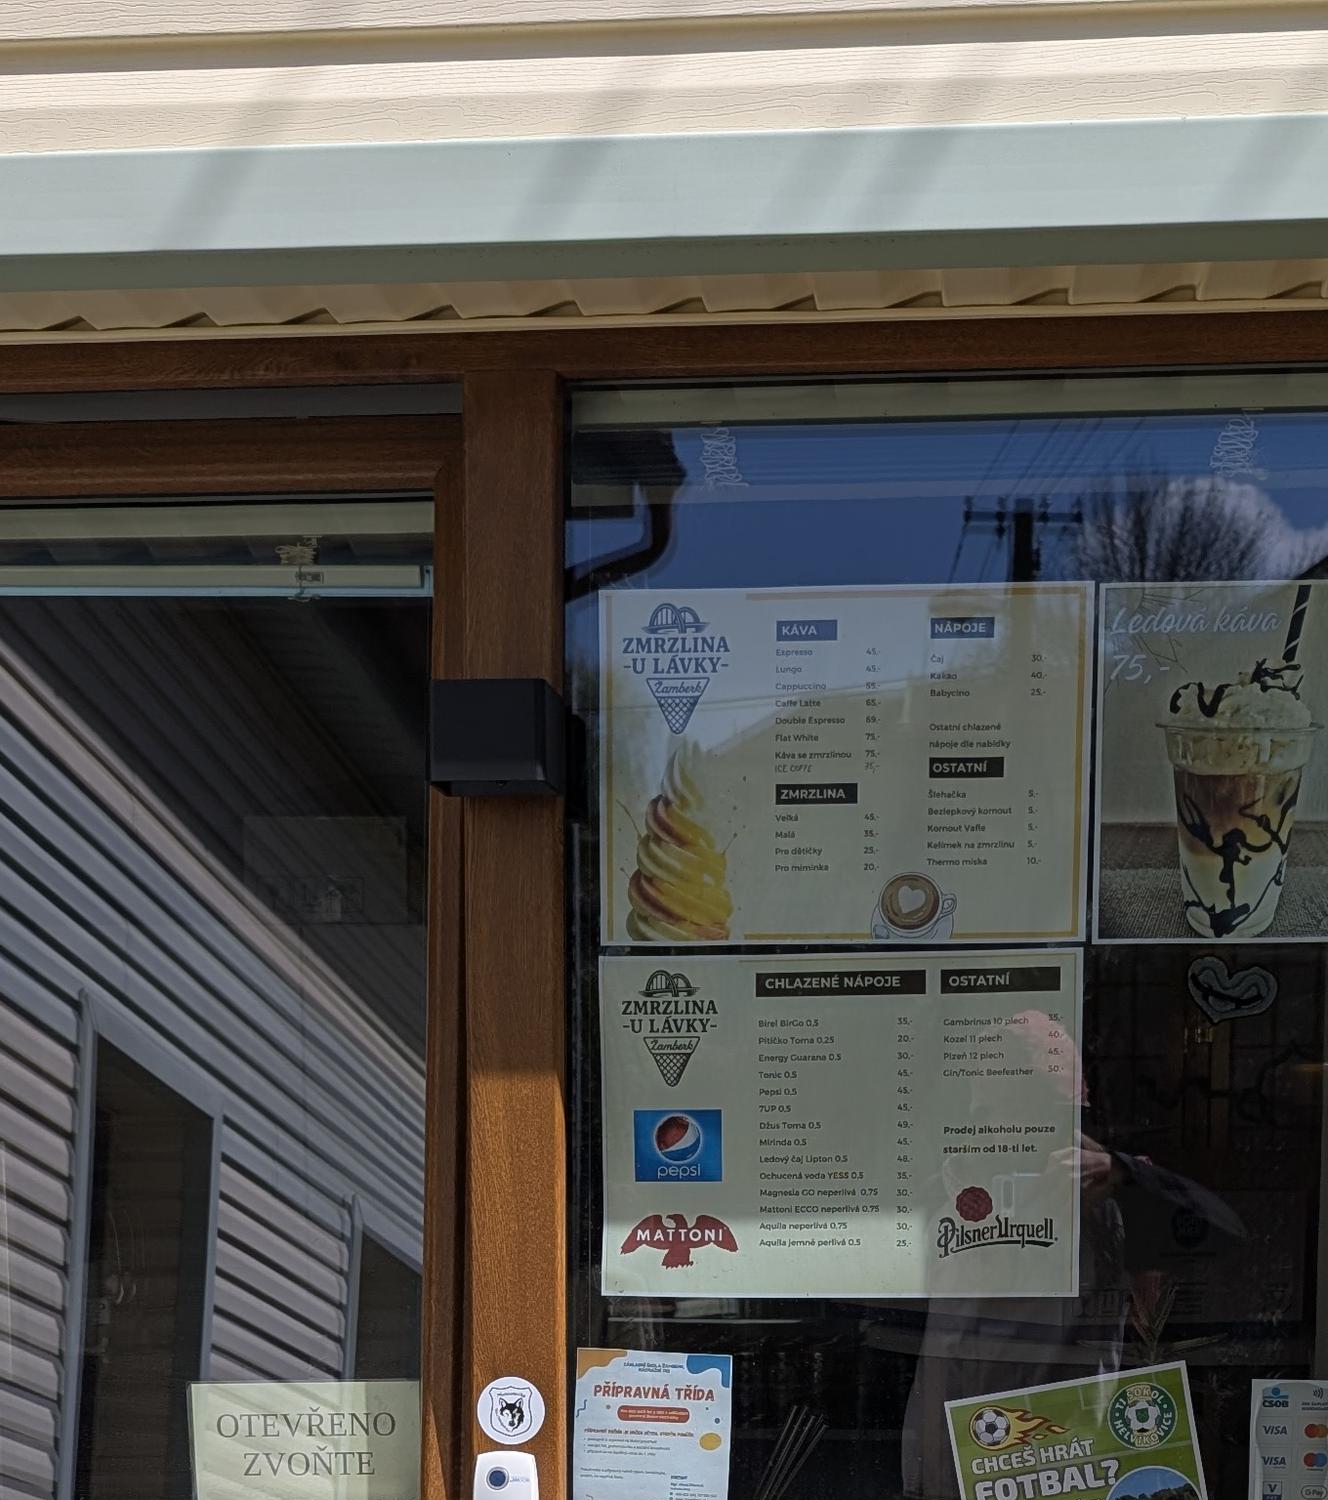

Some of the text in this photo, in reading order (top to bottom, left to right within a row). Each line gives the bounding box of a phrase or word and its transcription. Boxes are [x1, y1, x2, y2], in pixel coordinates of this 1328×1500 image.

[1110, 606, 1281, 635] Ledová káva
[782, 623, 817, 636] KÁVA
[934, 622, 986, 634] NÁPOJE
[622, 636, 731, 654] ZMRZLINA
[930, 653, 945, 664] Čaj
[774, 665, 802, 676] Lungo
[929, 672, 958, 681] Kakao
[654, 680, 703, 694] Žamberk
[774, 682, 827, 692] Cappuccino
[929, 688, 971, 699] Babycino
[799, 699, 822, 708] Latte
[774, 716, 846, 727] Double Espresso
[928, 721, 1002, 732] Ostatní chlazené
[774, 733, 819, 743] Flat White
[928, 739, 1012, 750] nápoje dle nabídky
[774, 749, 852, 760] Káva zmrzlinou
[932, 761, 988, 773] OSTATNÍ
[780, 788, 846, 800] ZMRZLINA
[928, 789, 967, 799] Šlehačka
[775, 813, 799, 822] Velká
[927, 806, 1012, 818] Bezlepkový kornout
[927, 823, 986, 833] Kornout Vafle
[775, 830, 796, 840] Malá
[976, 840, 1015, 850] zmrzlinu
[775, 847, 789, 856] Pro
[927, 857, 988, 867] Thermo miska
[775, 863, 829, 873] Pro miminka
[764, 973, 902, 990] CHLAZENÉ NÁPOJE
[948, 971, 1011, 987] OSTATNÍ
[621, 999, 718, 1016] ZMRZLINA
[758, 1018, 778, 1028] Birel
[943, 1016, 1029, 1027] Gambrinus plech
[790, 1036, 815, 1046] Toma
[943, 1033, 1003, 1044] Kozel plech
[650, 1038, 694, 1052] Žamberk
[758, 1053, 827, 1064] Energy Guarana
[943, 1051, 1005, 1061] Plzeň plech
[758, 1070, 783, 1080] Tonic
[943, 1068, 984, 1078] Gin/Tonic
[758, 1087, 782, 1098] Pepsi
[758, 1104, 777, 1113] 7UP
[759, 1121, 807, 1131] Džus Toma
[943, 1124, 1056, 1137] Prodej alkoholu pouze
[759, 1138, 792, 1147] Mirinda
[942, 1143, 1019, 1155] starším od 18-ti
[759, 1154, 833, 1165] Ledový Lipton
[657, 1162, 701, 1179] pepsi
[759, 1171, 850, 1181] Ochucená voda YESS
[816, 1188, 857, 1198] neperlivá
[759, 1205, 793, 1214] Mattoni
[820, 1205, 860, 1215] neperlivá
[759, 1221, 828, 1232] Aquila neperlivá
[636, 1227, 724, 1242] MATTONI
[936, 1215, 998, 1259] Pilsner
[759, 1238, 787, 1249] Aquila
[817, 1238, 847, 1248] perlivá
[593, 1380, 715, 1402] PŘÍPRAVNÁ TŘÍDA
[1114, 1384, 1164, 1409] TJ SOKOL
[215, 1406, 397, 1439] OTEVŘENO
[1113, 1409, 1174, 1447] HELVÍKOVICE
[1262, 1425, 1288, 1436] VISA
[971, 1435, 1095, 1475] CHCEŠ HRÁT
[243, 1445, 376, 1477] ZVOŇTE
[1261, 1456, 1287, 1466] VISA
